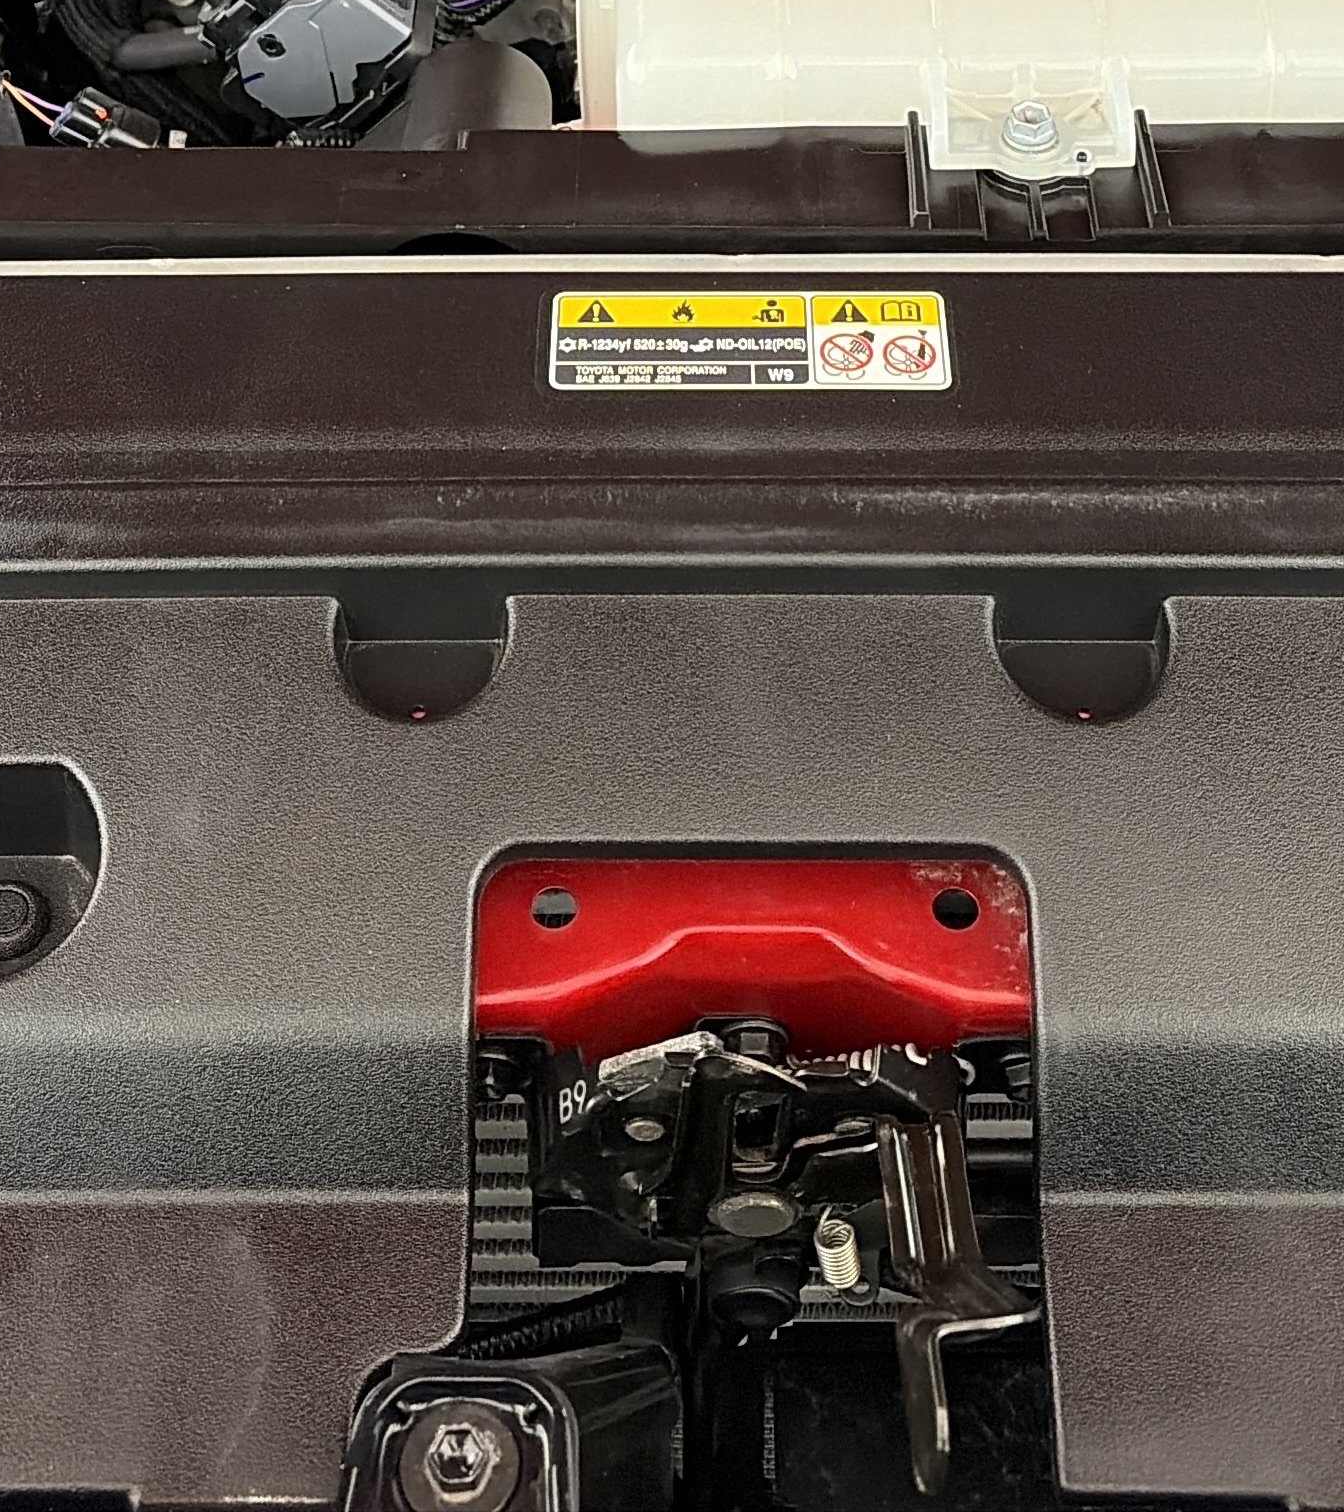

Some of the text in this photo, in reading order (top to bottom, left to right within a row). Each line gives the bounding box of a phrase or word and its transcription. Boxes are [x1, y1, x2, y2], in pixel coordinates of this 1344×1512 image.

[577, 337, 807, 353] R-1234yf 520±30g ND-OIL12(POE)
[575, 365, 728, 376] TOYOTA MOTOR CORPORATION
[767, 367, 795, 382] W9
[559, 1079, 587, 1125] B9
